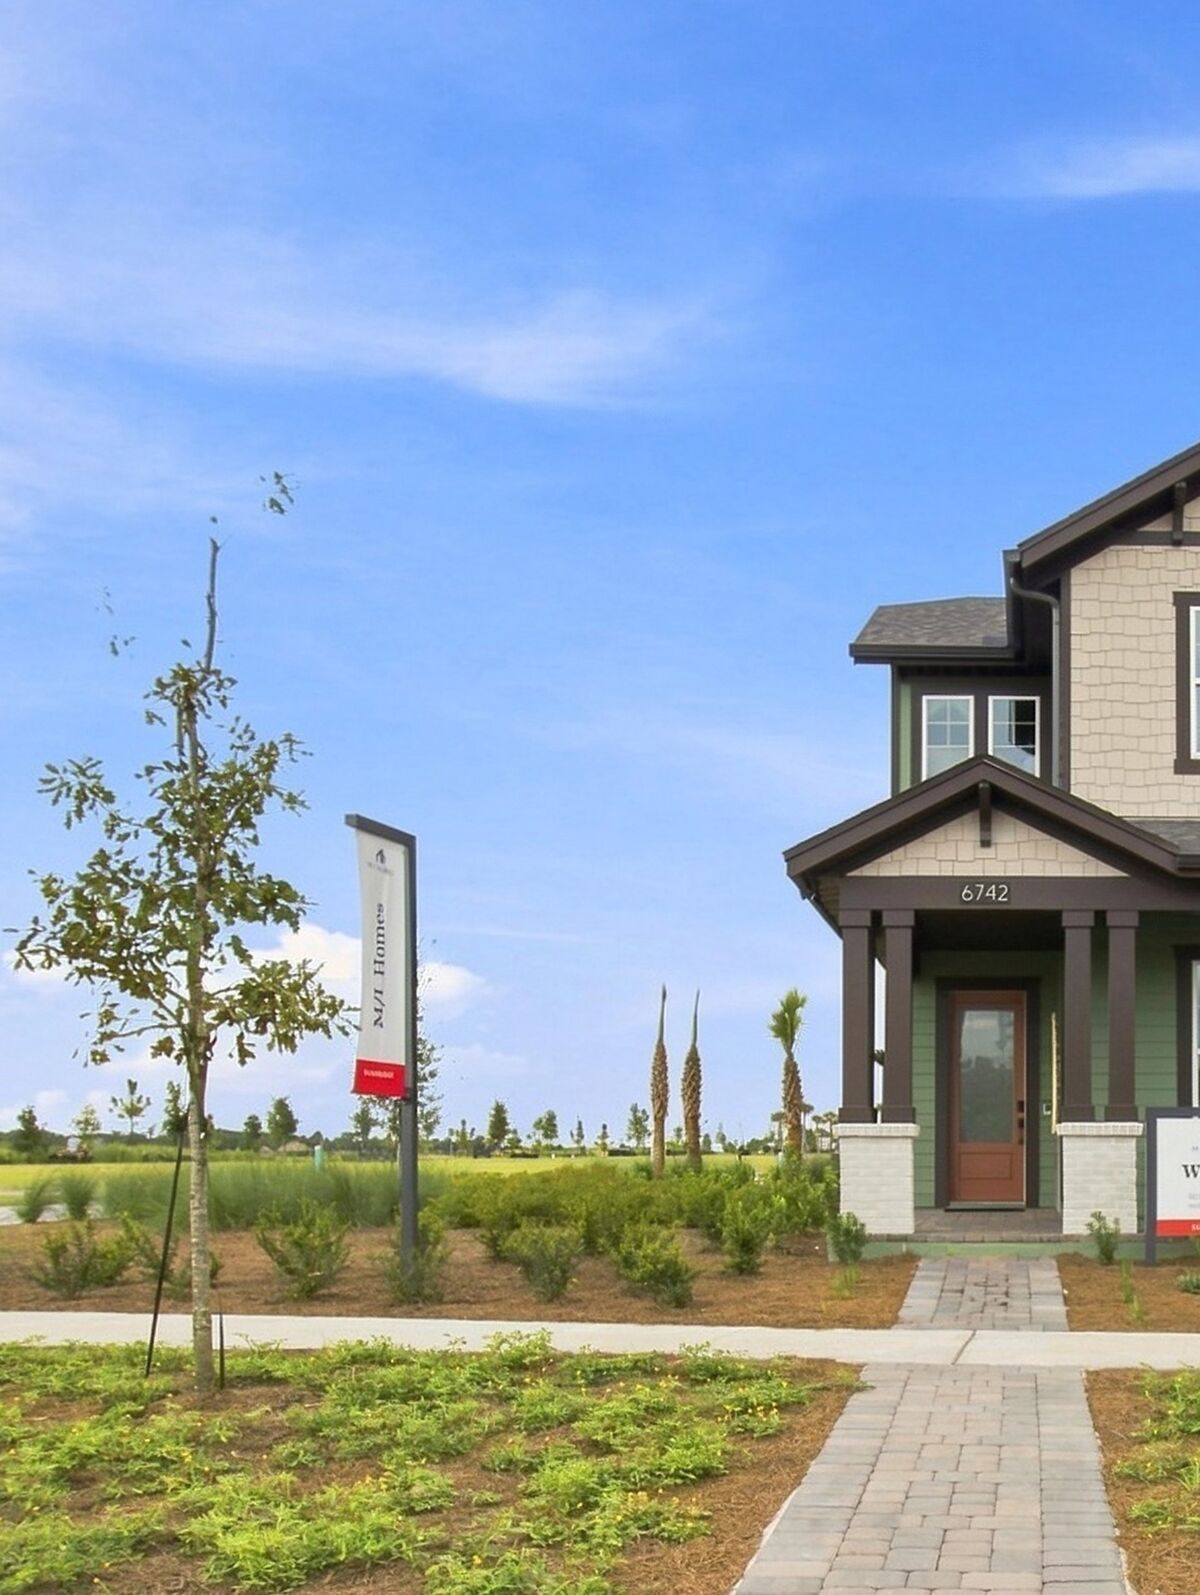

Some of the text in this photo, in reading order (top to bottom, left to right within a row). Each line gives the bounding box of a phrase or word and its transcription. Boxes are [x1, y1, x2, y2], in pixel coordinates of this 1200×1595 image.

[961, 884, 1009, 902] 6742
[373, 903, 386, 1029] M/I Homes
